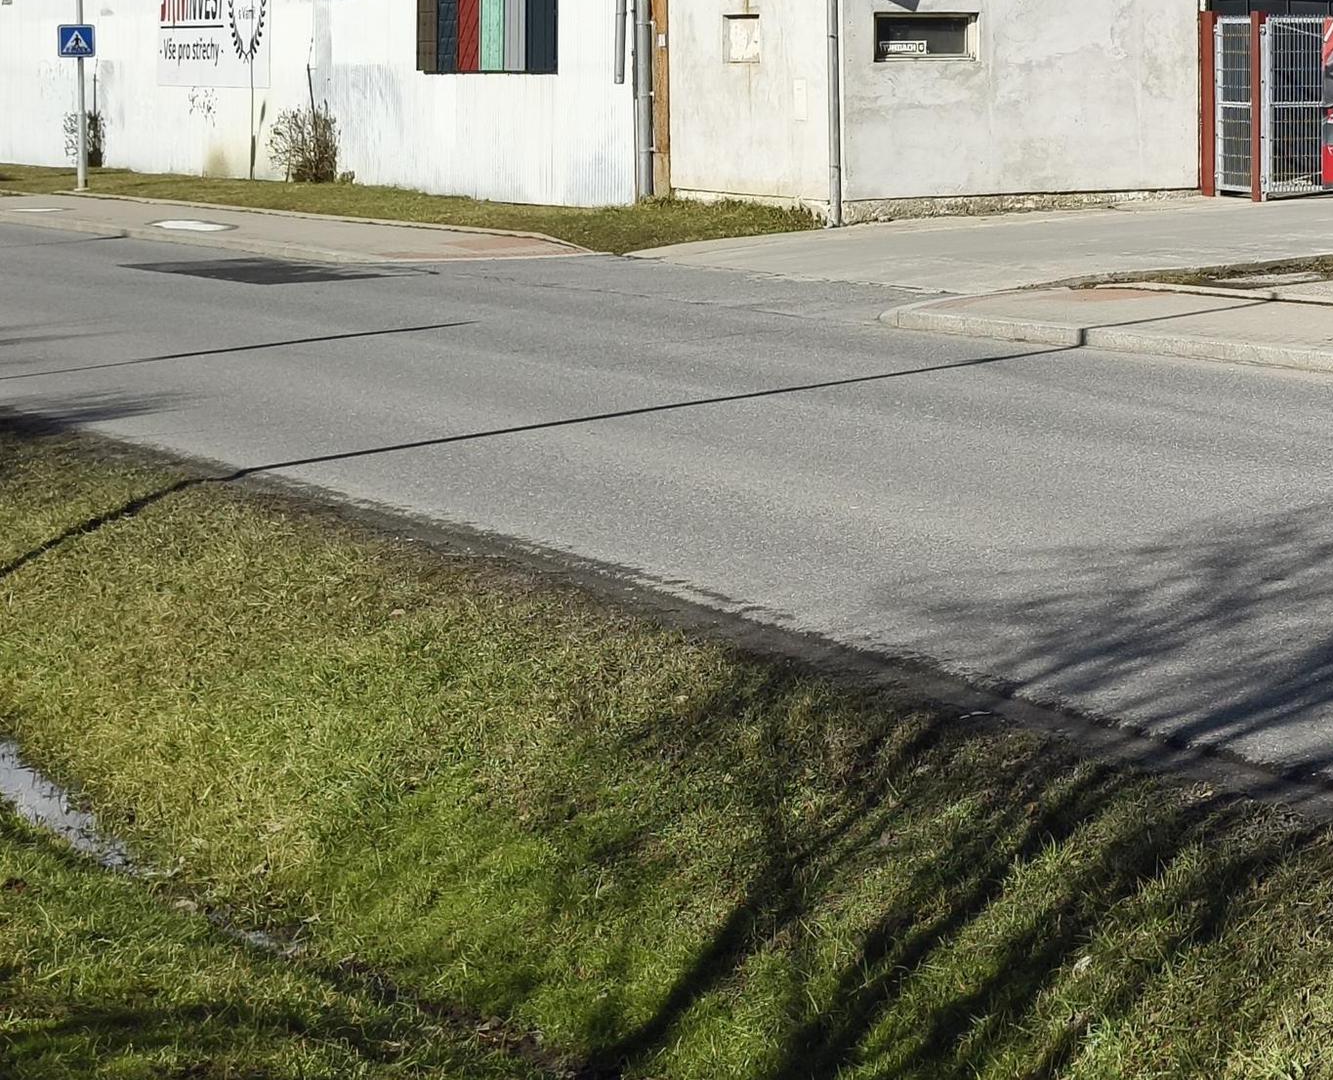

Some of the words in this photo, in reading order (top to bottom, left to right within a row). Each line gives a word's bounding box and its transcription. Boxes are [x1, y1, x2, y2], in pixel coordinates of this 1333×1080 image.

[163, 37, 177, 60] Vše
[178, 43, 190, 66] pro
[192, 37, 219, 67] střechy
